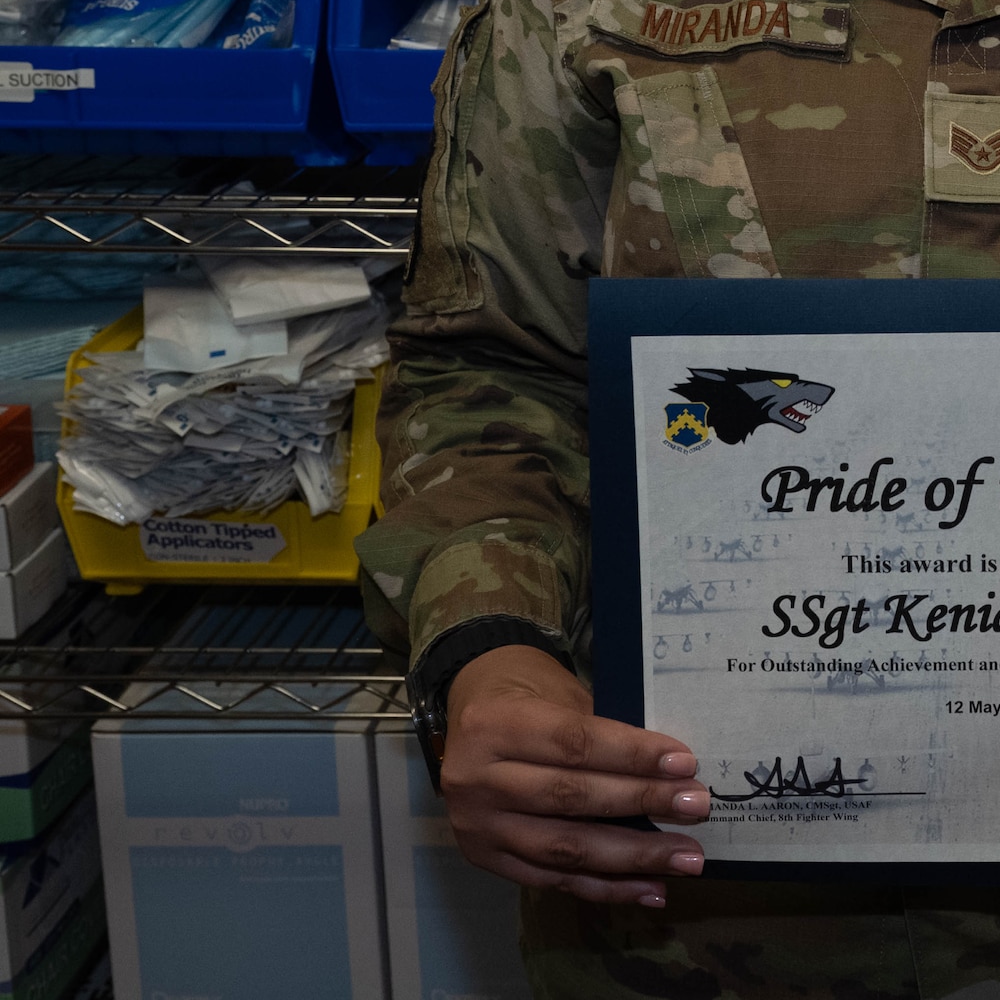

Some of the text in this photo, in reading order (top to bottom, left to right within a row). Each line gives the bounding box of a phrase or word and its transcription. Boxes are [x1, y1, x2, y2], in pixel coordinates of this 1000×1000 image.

[639, 1, 793, 44] MIRANDA
[9, 72, 79, 88] SUCTION
[761, 456, 907, 513] Pride
[923, 455, 996, 530] of
[143, 518, 276, 539] Cotton Tipped
[147, 533, 254, 551] Applicators
[842, 553, 892, 574] This
[900, 554, 973, 574] award
[980, 554, 998, 573] is
[761, 591, 871, 649] SSgt
[726, 657, 756, 673] For
[760, 657, 865, 676] Outstanding
[868, 656, 973, 674] Achievement
[945, 699, 963, 716] 12
[710, 800, 872, 813] ANDA L. AARON, CMSgt, USAF
[748, 813, 776, 824] Chief,
[779, 813, 794, 823] 8th
[797, 813, 830, 825] Fighter
[833, 812, 858, 825] Wing
